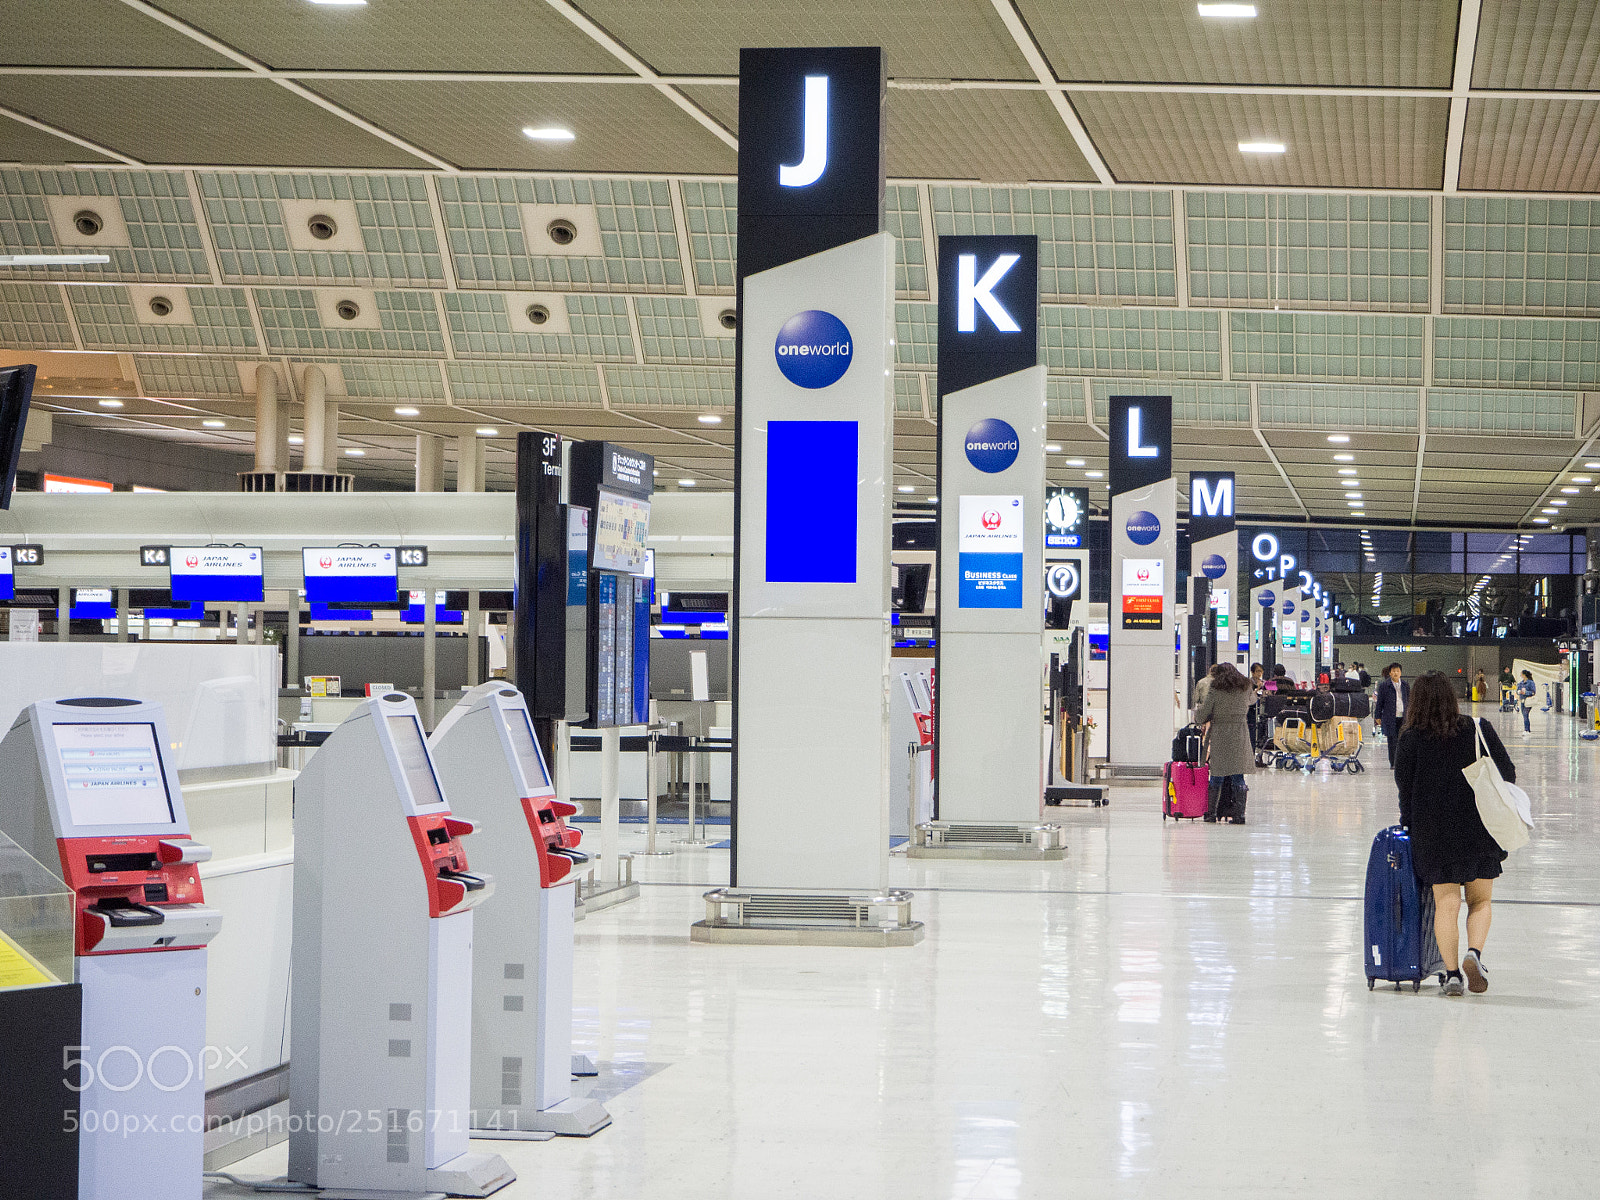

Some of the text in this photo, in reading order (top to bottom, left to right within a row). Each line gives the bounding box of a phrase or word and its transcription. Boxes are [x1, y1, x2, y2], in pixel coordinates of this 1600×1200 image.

[779, 76, 829, 188] J
[957, 254, 1021, 333] K
[778, 341, 850, 356] oneworld
[1127, 407, 1159, 457] L
[542, 437, 557, 457] 3F
[966, 440, 1017, 451] oneworld
[542, 461, 562, 477] Termi
[1191, 478, 1233, 516] M
[1252, 533, 1278, 560] O
[16, 549, 38, 563] K5
[144, 549, 165, 564] K4
[401, 549, 423, 564] K3
[964, 570, 1002, 579] BUSINESS
[1279, 554, 1295, 578] P
